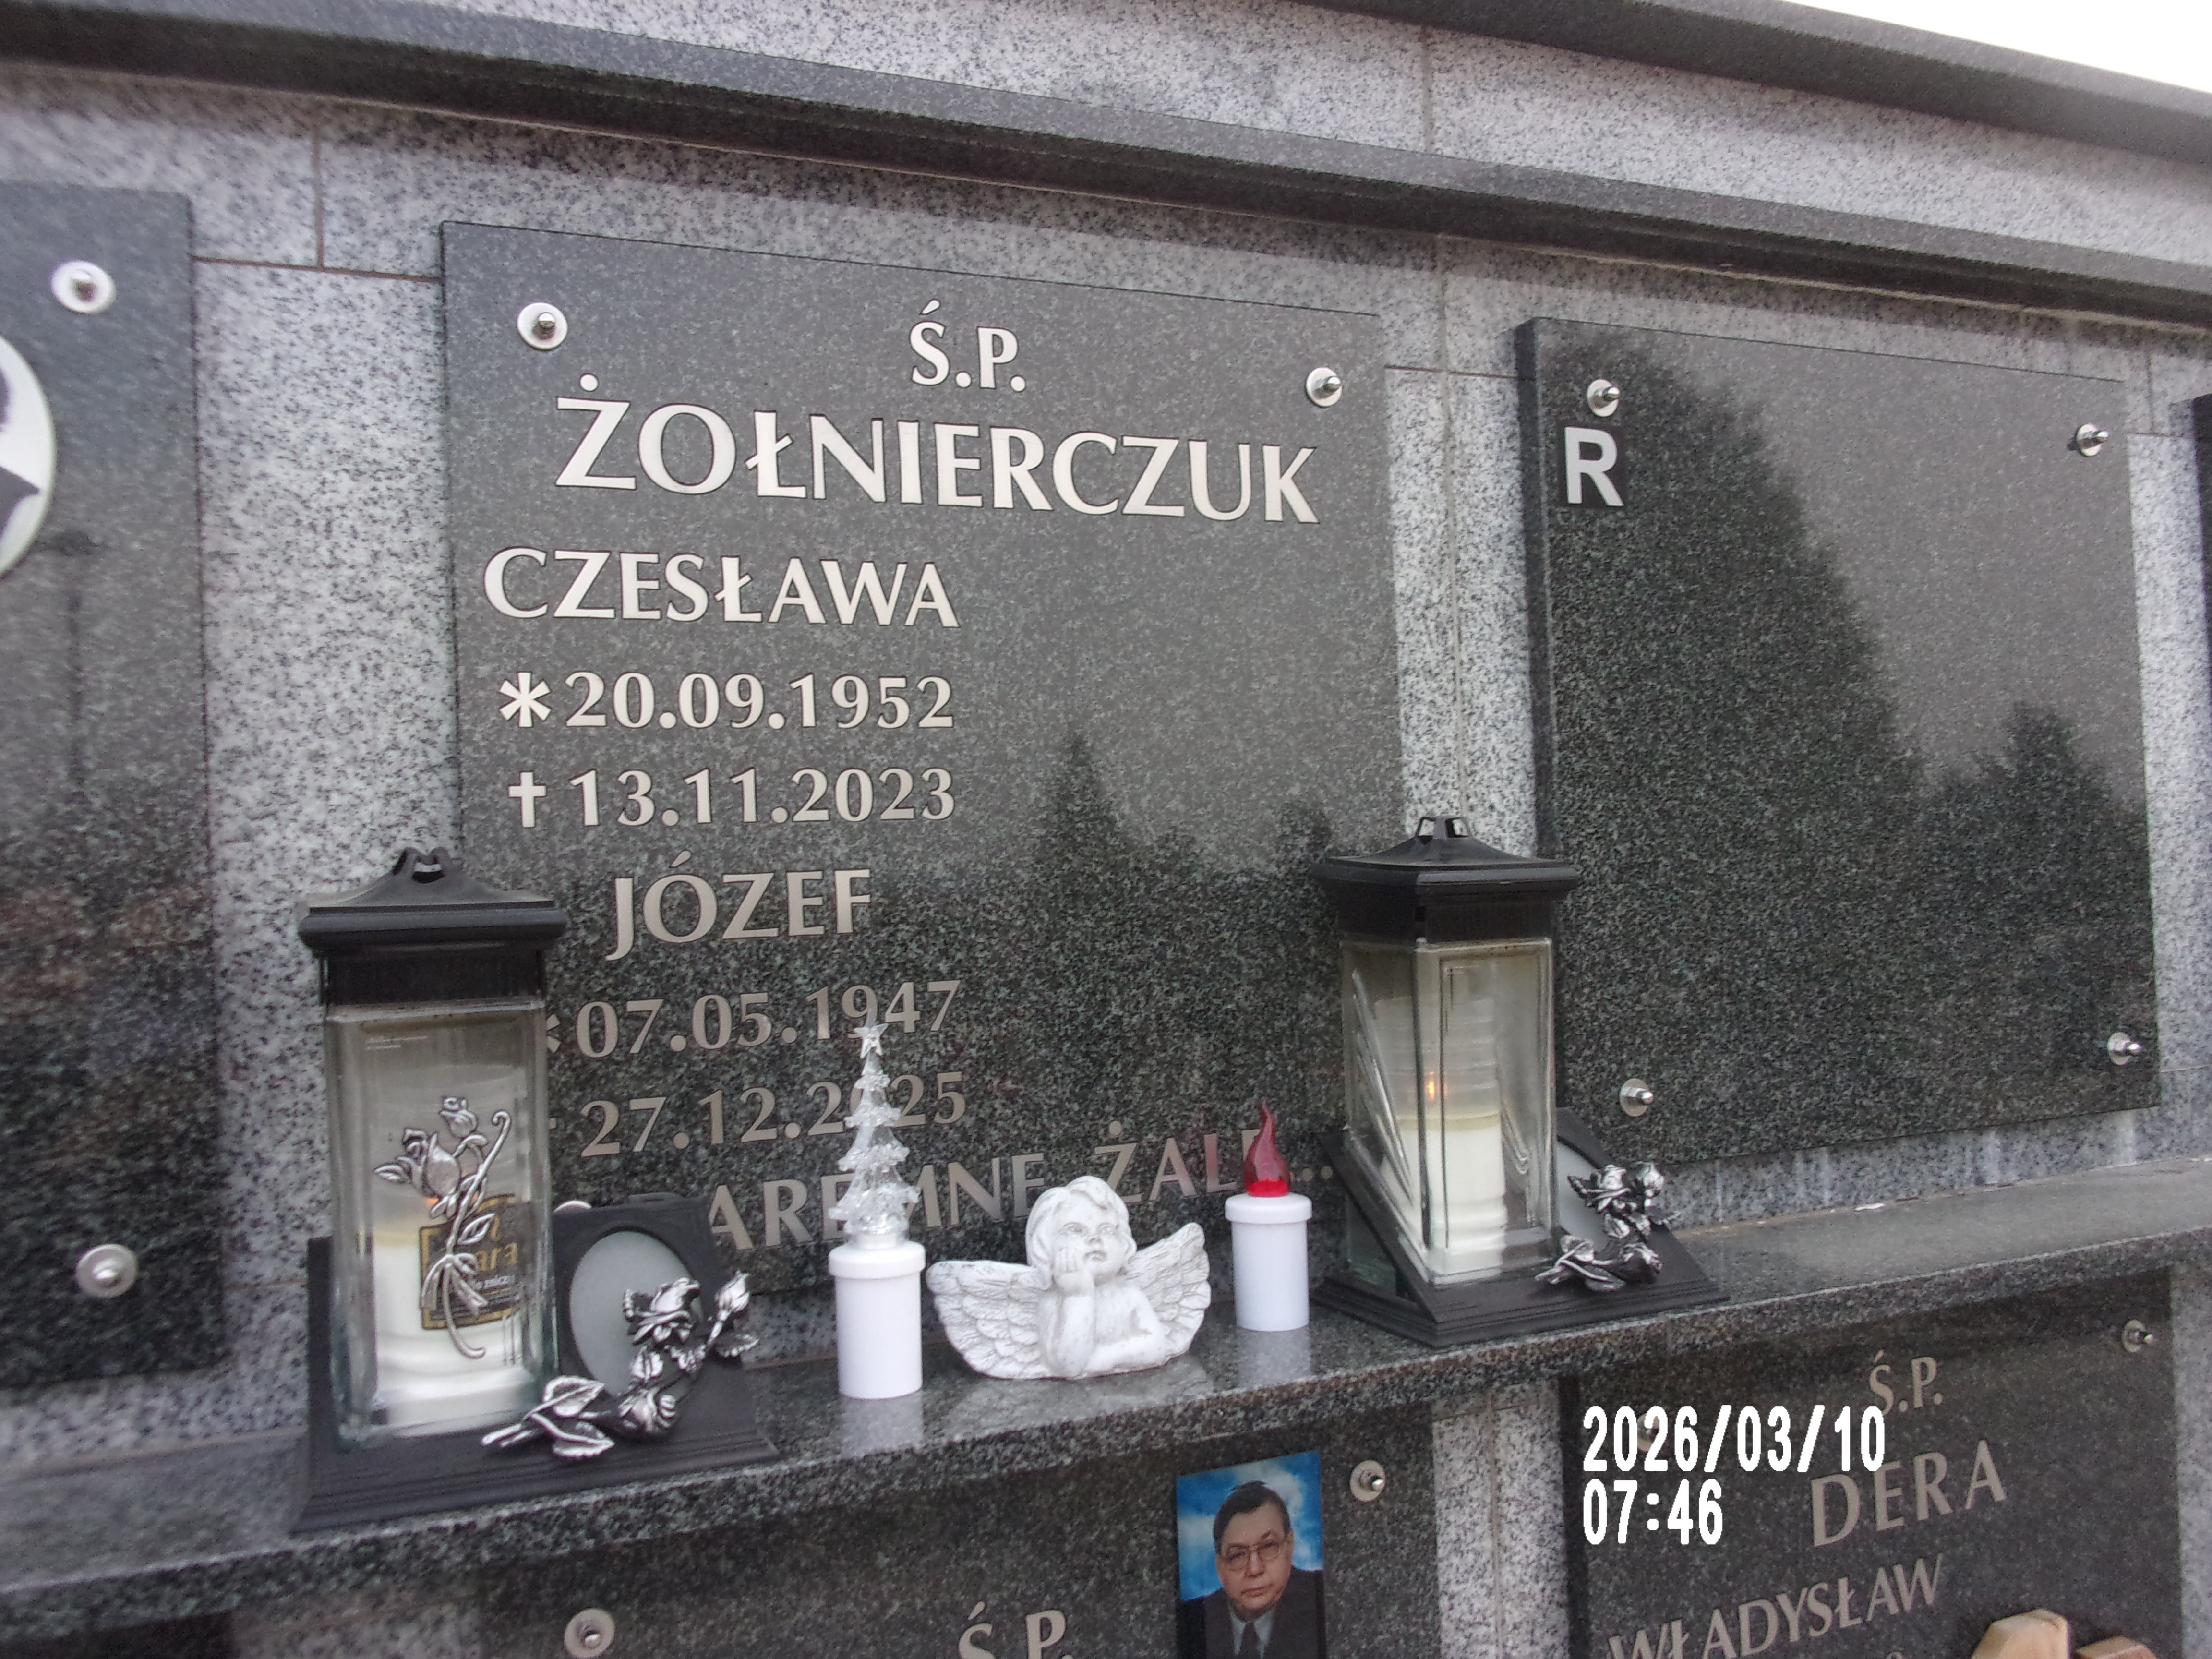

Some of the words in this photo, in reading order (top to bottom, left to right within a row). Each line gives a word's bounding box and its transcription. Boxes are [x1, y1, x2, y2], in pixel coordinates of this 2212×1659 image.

[910, 300, 1027, 393] Ś.P.
[555, 373, 1320, 524] ŻOŁNIERCZUK
[1564, 426, 1624, 507] R
[483, 547, 961, 629] CZESŁAWA
[565, 671, 955, 729] 20.09.1952
[569, 768, 956, 827] 13.11.2023
[605, 850, 871, 961] JÓZEF
[576, 979, 961, 1058] 07.05.1947
[1869, 1348, 1944, 1417] Ś.P.
[1811, 1440, 2007, 1548] DERA
[1606, 1553, 1943, 1659] WŁADYSŁAW
